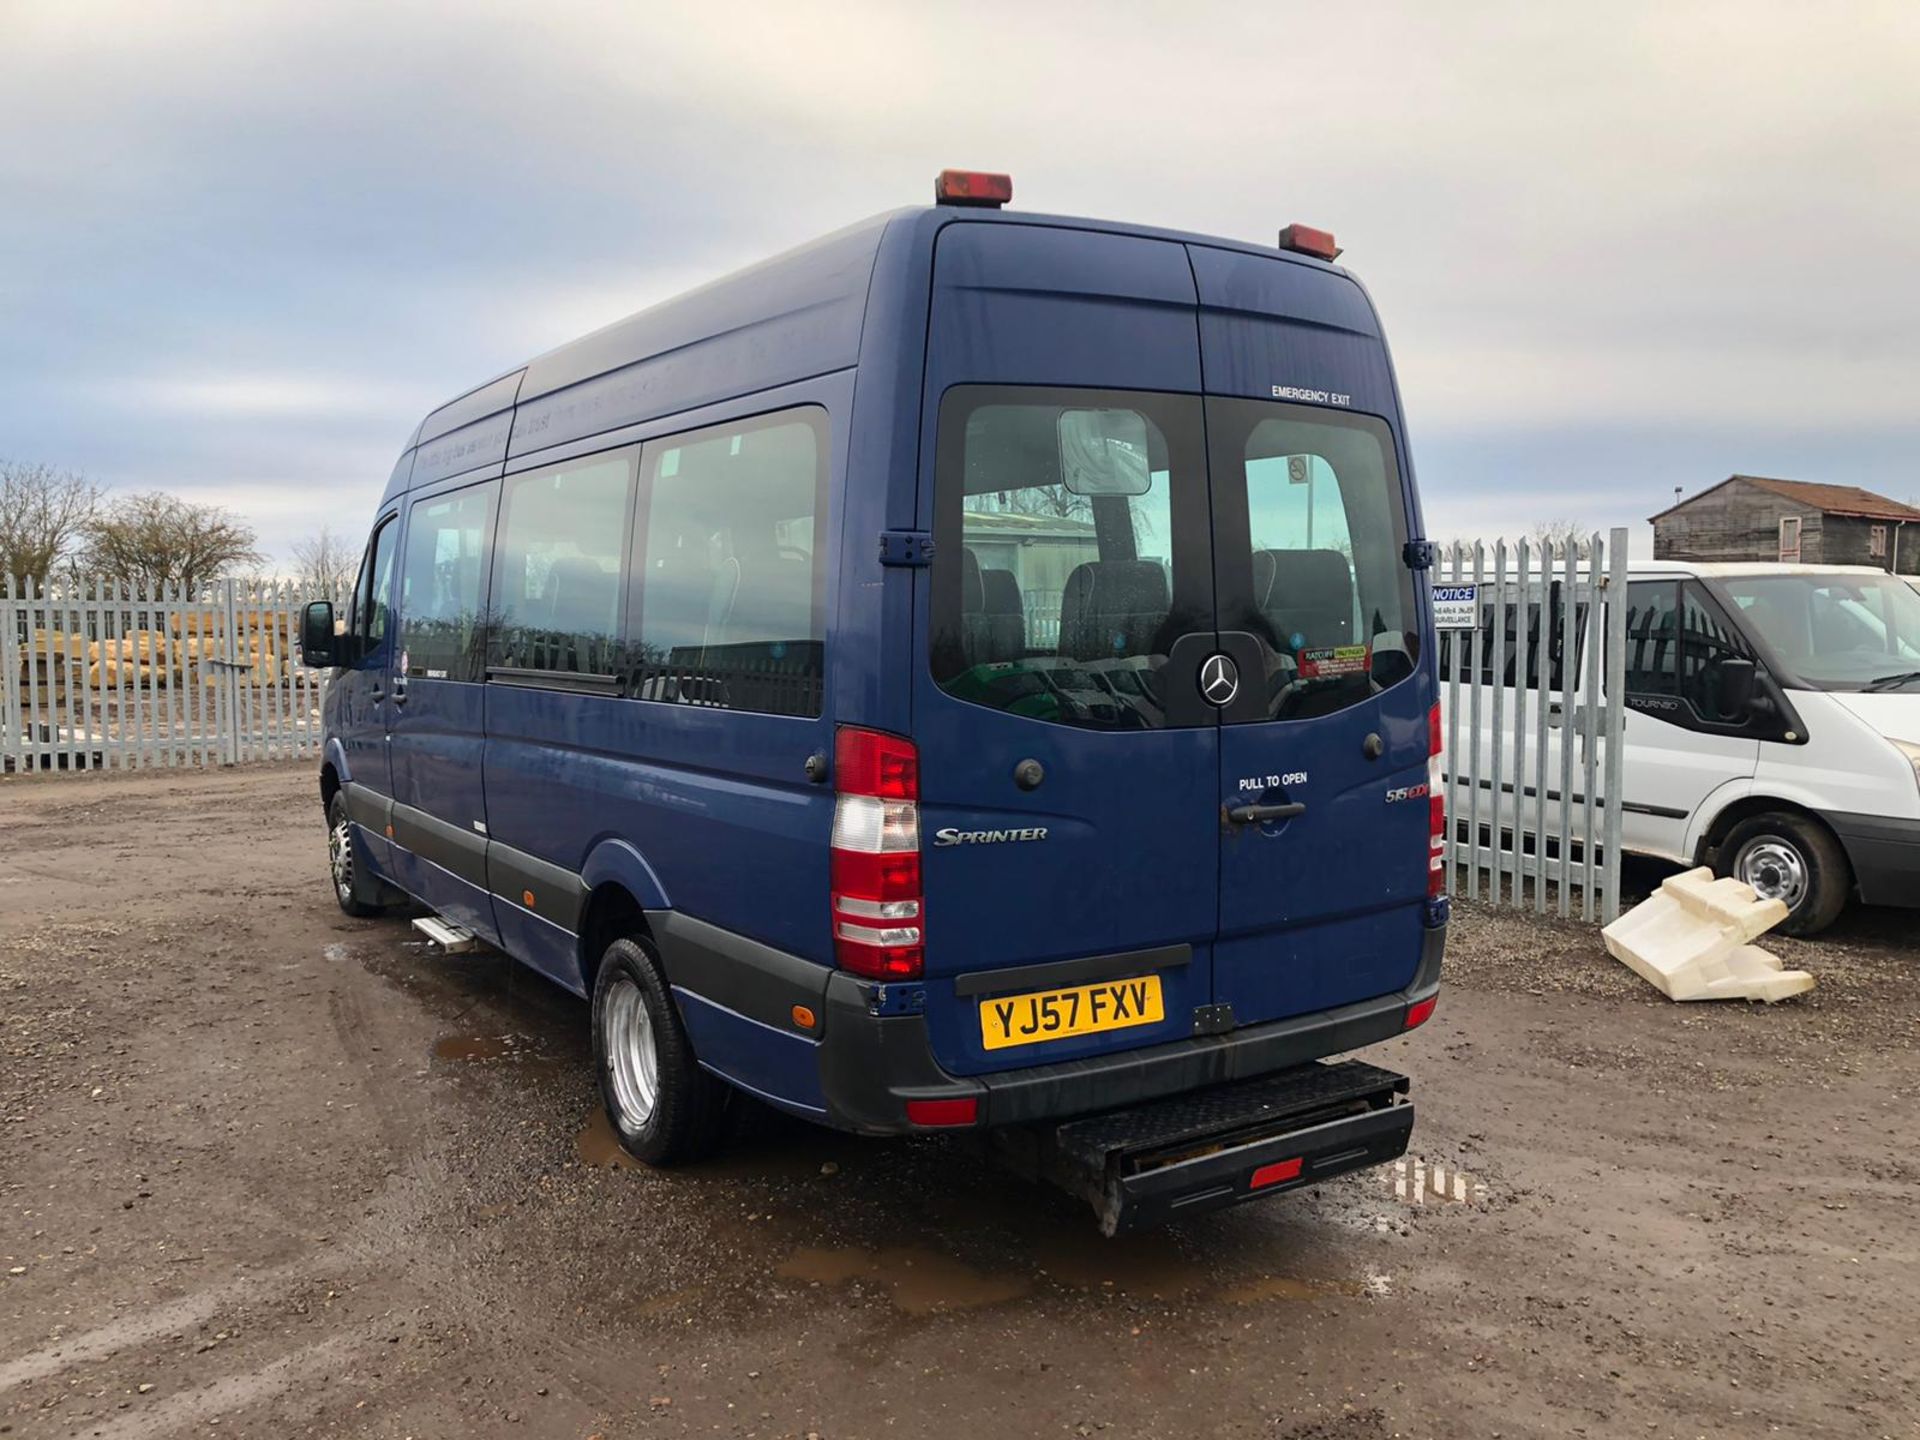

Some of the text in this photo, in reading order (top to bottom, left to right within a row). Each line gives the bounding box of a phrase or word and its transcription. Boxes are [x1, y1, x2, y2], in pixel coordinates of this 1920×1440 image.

[1272, 385, 1350, 406] EMERGENCY EXIT
[1433, 587, 1472, 600] NOTICE
[1239, 772, 1307, 790] PULL TO OPEN
[995, 982, 1147, 1038] YJ57 FXV
